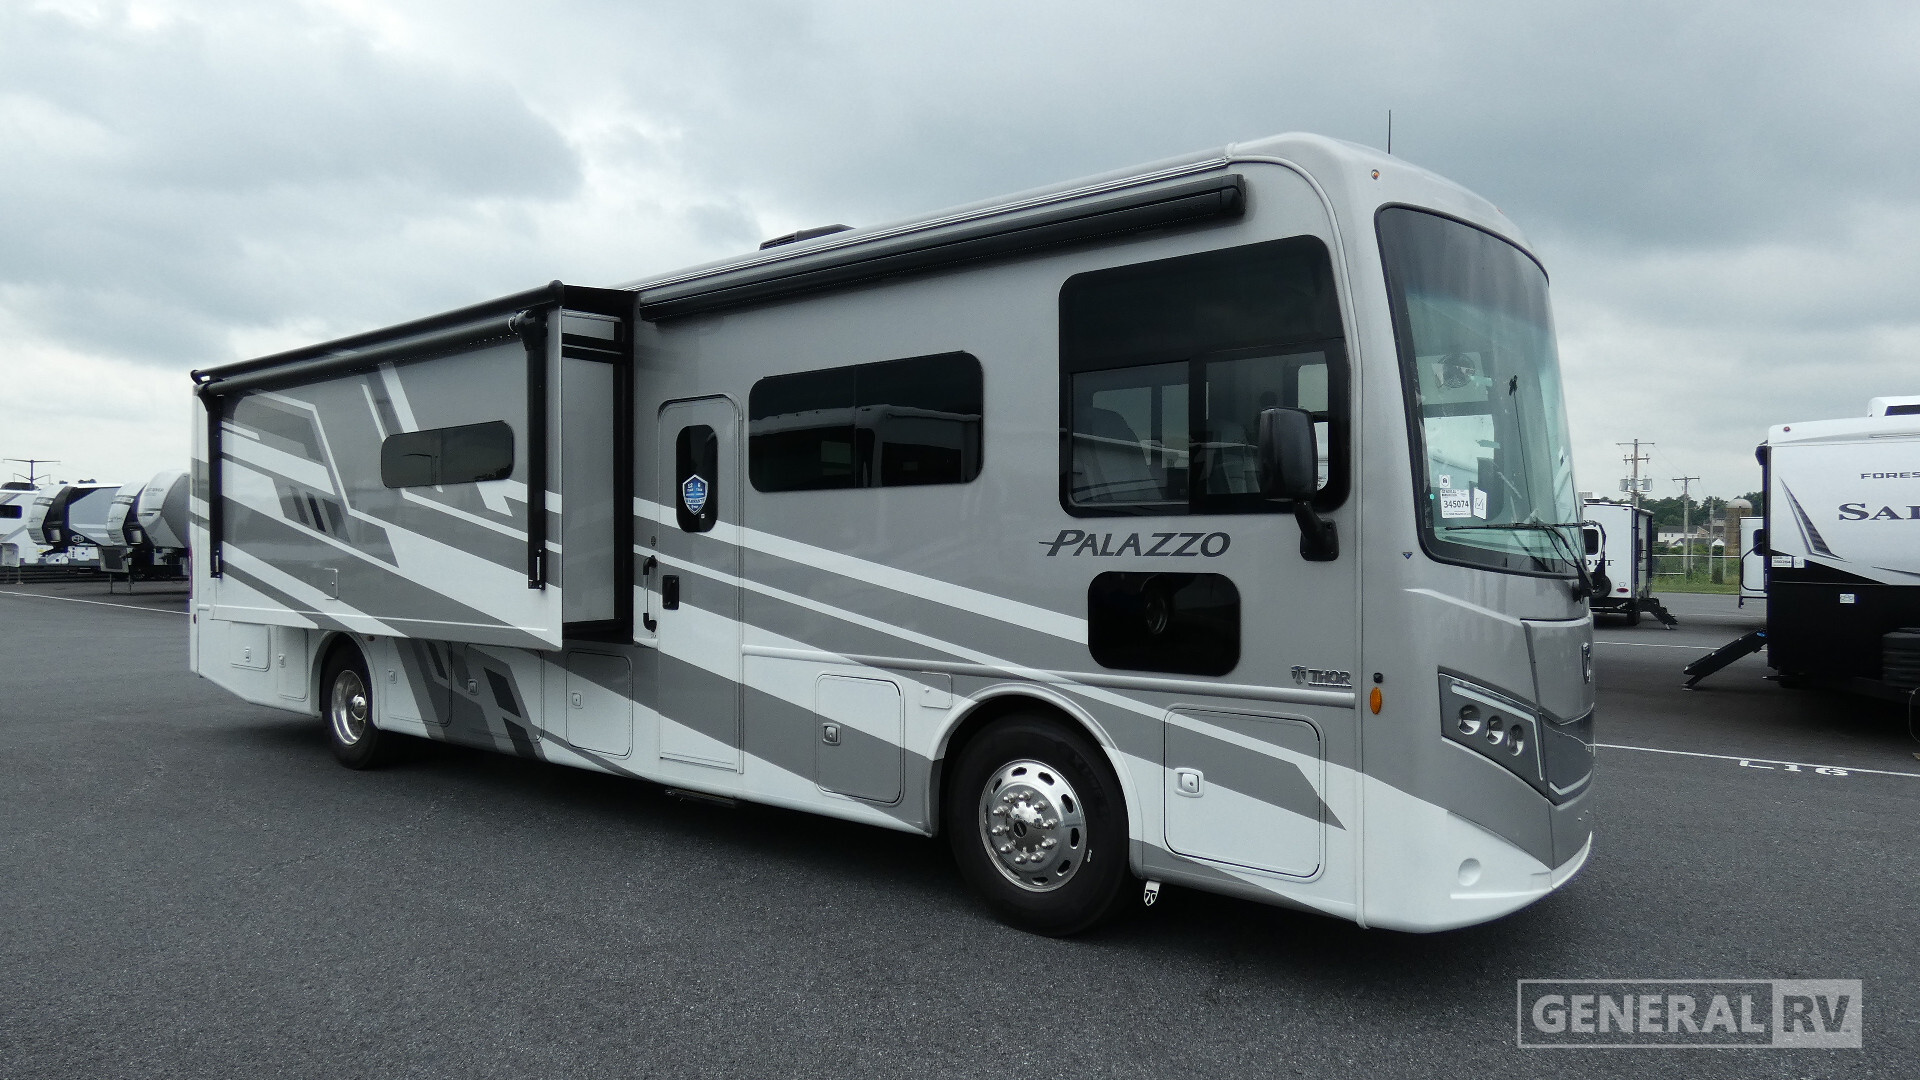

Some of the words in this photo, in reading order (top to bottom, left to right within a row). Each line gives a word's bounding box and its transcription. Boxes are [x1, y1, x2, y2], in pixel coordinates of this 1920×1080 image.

[1443, 500, 1469, 508] 345074
[1039, 529, 1231, 557] PALAZZO
[1308, 669, 1352, 685] THOR
